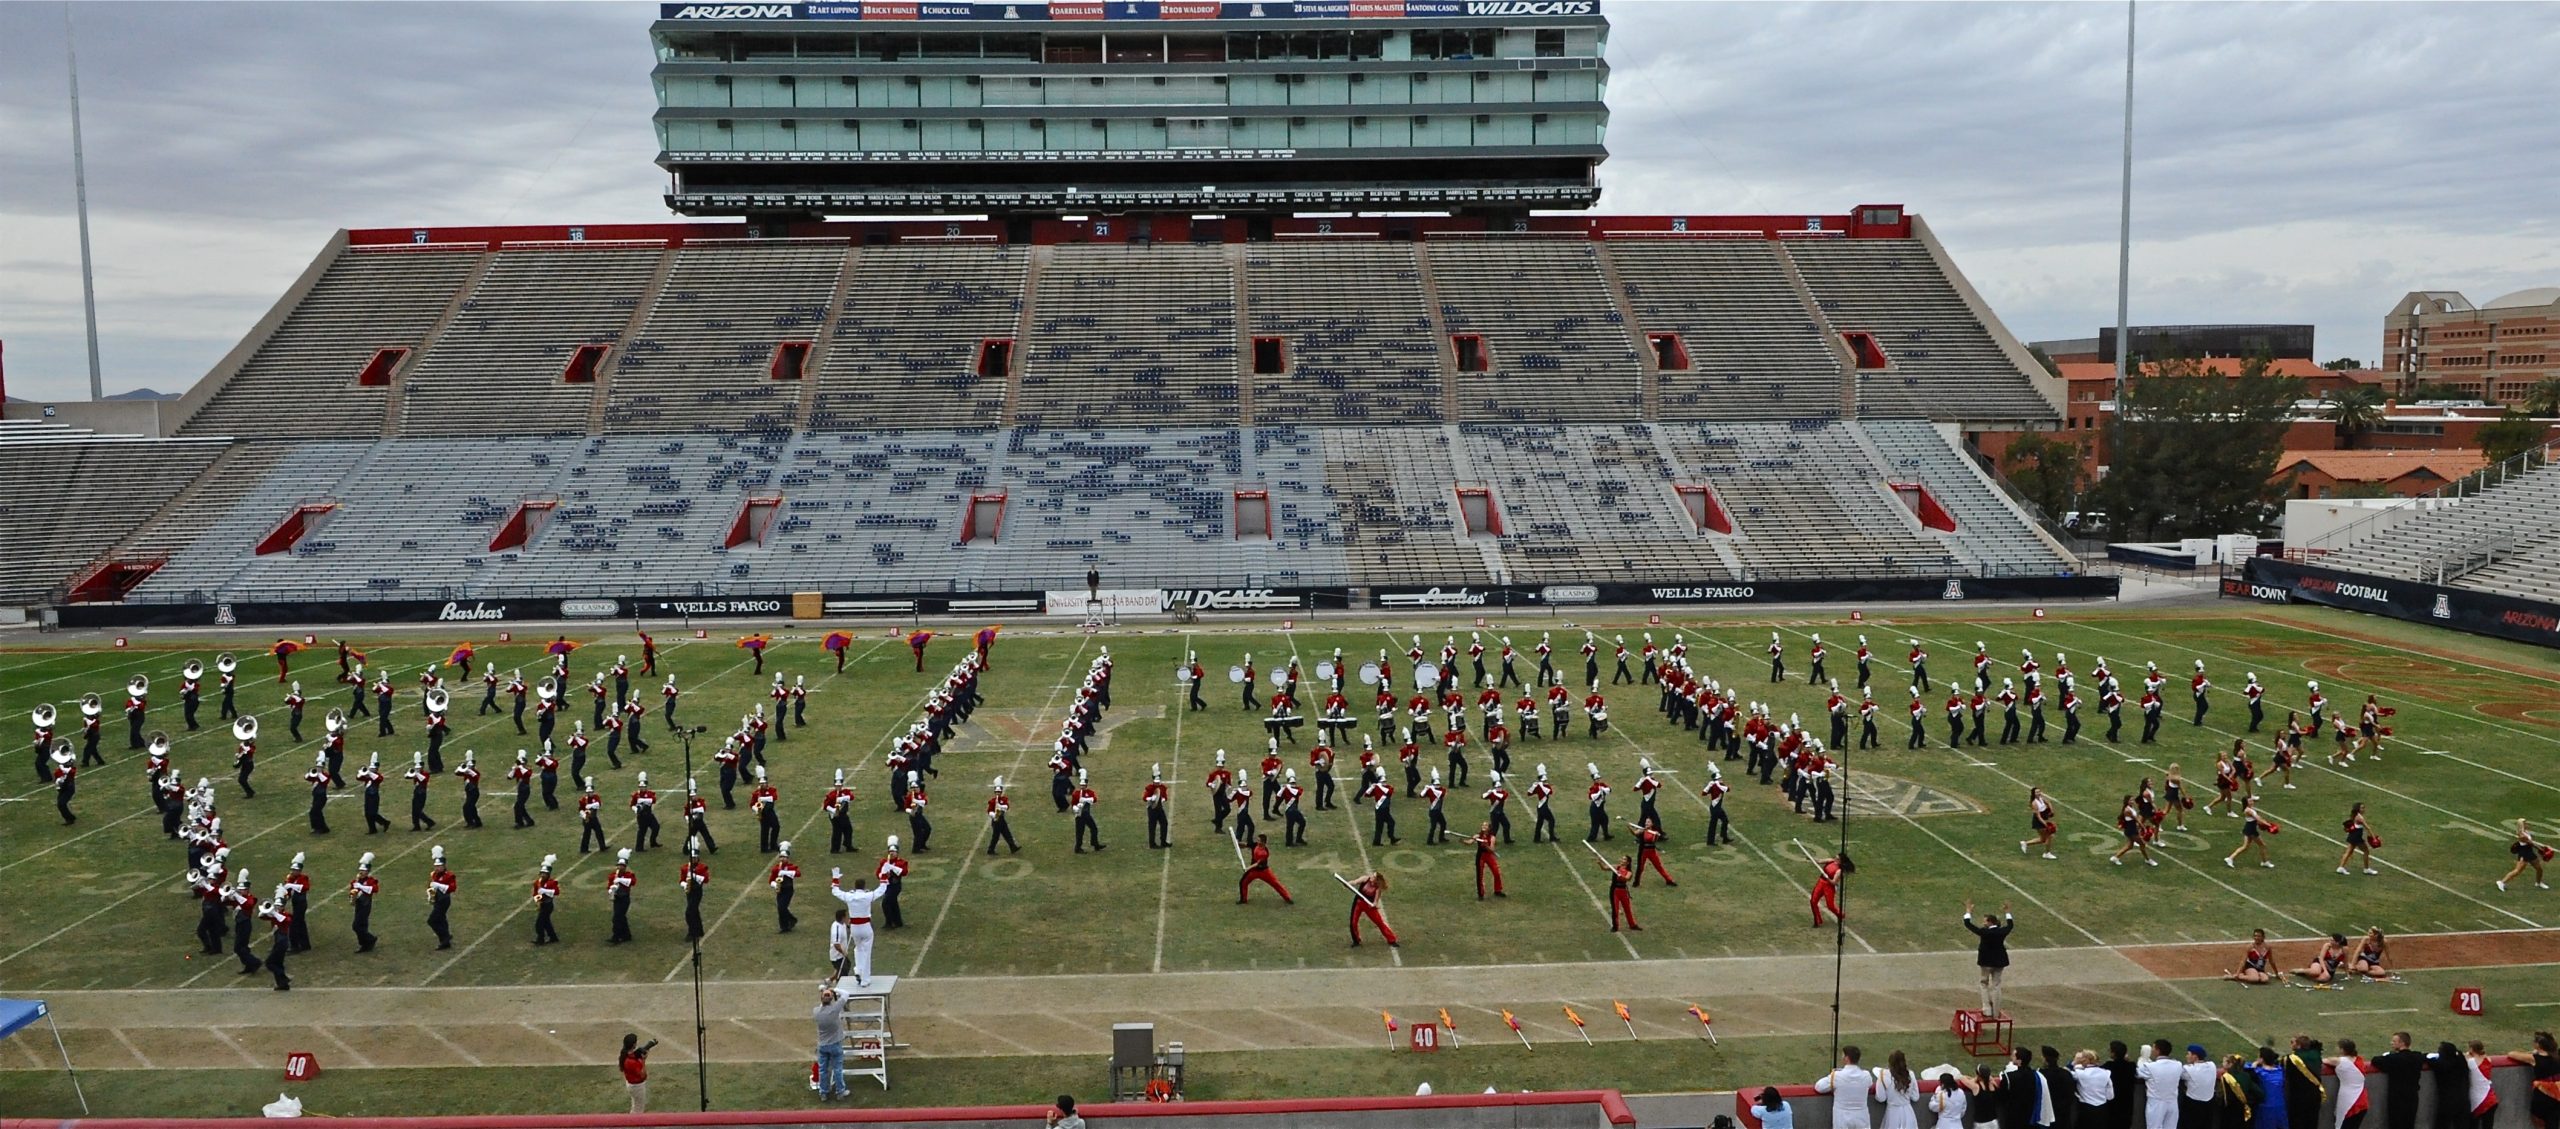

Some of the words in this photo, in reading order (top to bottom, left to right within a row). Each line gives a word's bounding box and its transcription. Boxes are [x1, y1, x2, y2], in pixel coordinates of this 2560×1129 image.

[675, 5, 793, 18] ARIZONA
[808, 5, 817, 14] 22
[817, 6, 830, 14] ART
[830, 6, 859, 14] LUPPINO
[928, 7, 951, 15] CHUCK
[951, 7, 970, 15] CECIL
[1183, 6, 1215, 14] WALDROP
[1356, 4, 1374, 12] CHRIS
[1374, 4, 1405, 12] McALISTER
[1437, 4, 1459, 12] CASON
[1467, 2, 1592, 15] WILDCATS
[1097, 226, 1108, 235] 21
[1319, 225, 1332, 233] 22
[1514, 223, 1528, 232] 23
[1673, 223, 1686, 231] 24
[1808, 222, 1821, 231] 25
[571, 232, 583, 241] 18
[749, 230, 760, 238] 19
[947, 228, 960, 236] 20
[416, 235, 426, 244] 17
[44, 407, 55, 416] 16
[1652, 588, 1702, 599] WELLS
[1705, 587, 1754, 598] FARGO
[2298, 576, 2338, 593] ARIZONA
[2336, 582, 2389, 602] FOOTBALL
[1048, 598, 1084, 608] UNIVERSITY
[1125, 596, 1144, 606] BAND
[1145, 596, 1158, 606] DAY
[439, 602, 506, 620] Bashas'
[674, 602, 727, 613] WELLS
[730, 601, 780, 612] FARGO
[2502, 610, 2557, 630] ARIZONA
[2460, 993, 2479, 1012] 20
[1415, 1027, 1433, 1047] 40
[287, 1056, 306, 1077] 40
